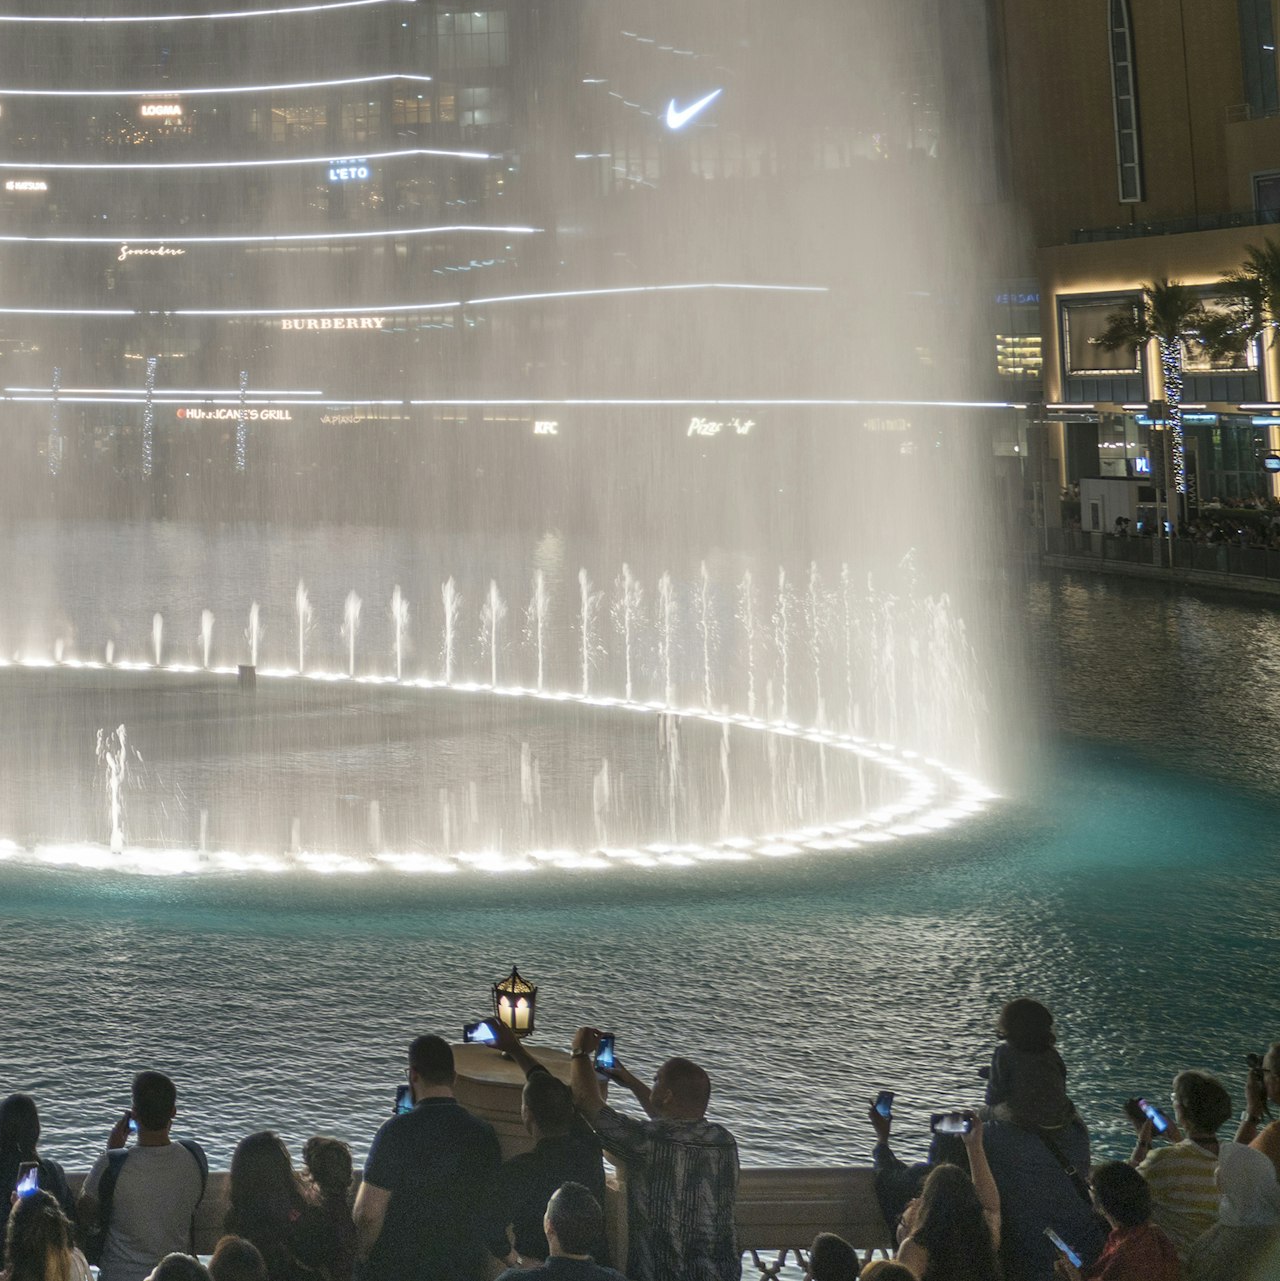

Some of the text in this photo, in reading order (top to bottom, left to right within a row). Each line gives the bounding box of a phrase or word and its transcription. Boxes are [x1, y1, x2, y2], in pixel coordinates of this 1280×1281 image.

[141, 105, 182, 117] LOGMA
[328, 167, 369, 181] L'ETO
[117, 245, 186, 261] Somewhere
[281, 317, 386, 331] BURBERRY
[260, 409, 292, 420] GRILL
[320, 415, 361, 425] VAPIANO
[534, 421, 559, 434] KFC
